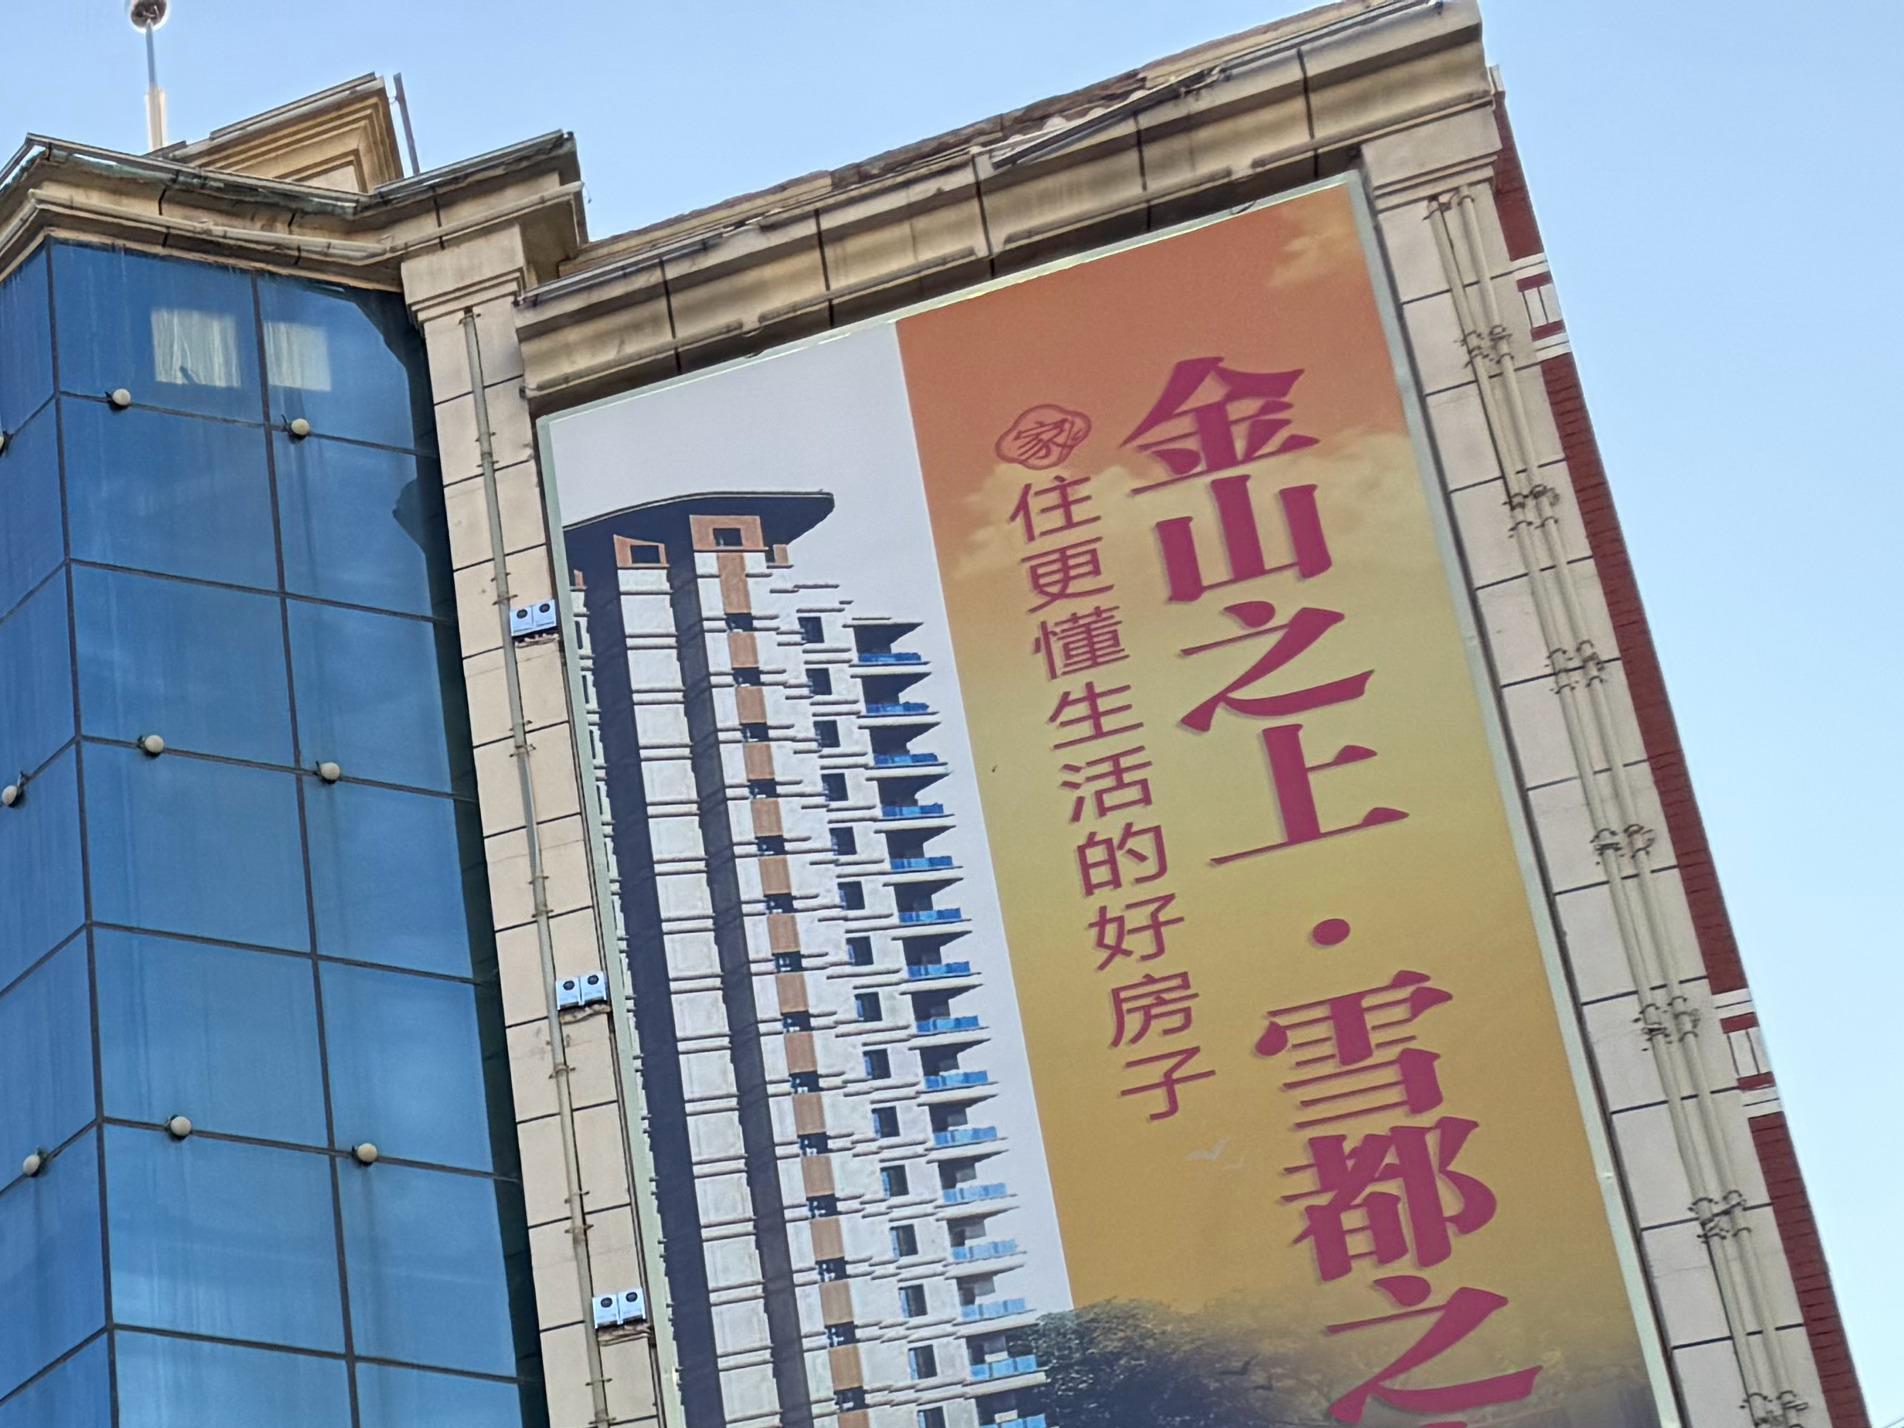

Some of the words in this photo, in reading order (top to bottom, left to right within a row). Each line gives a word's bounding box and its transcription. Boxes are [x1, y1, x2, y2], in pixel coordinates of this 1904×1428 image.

[1008, 474, 1216, 1121] 住更懂生活的好房子
